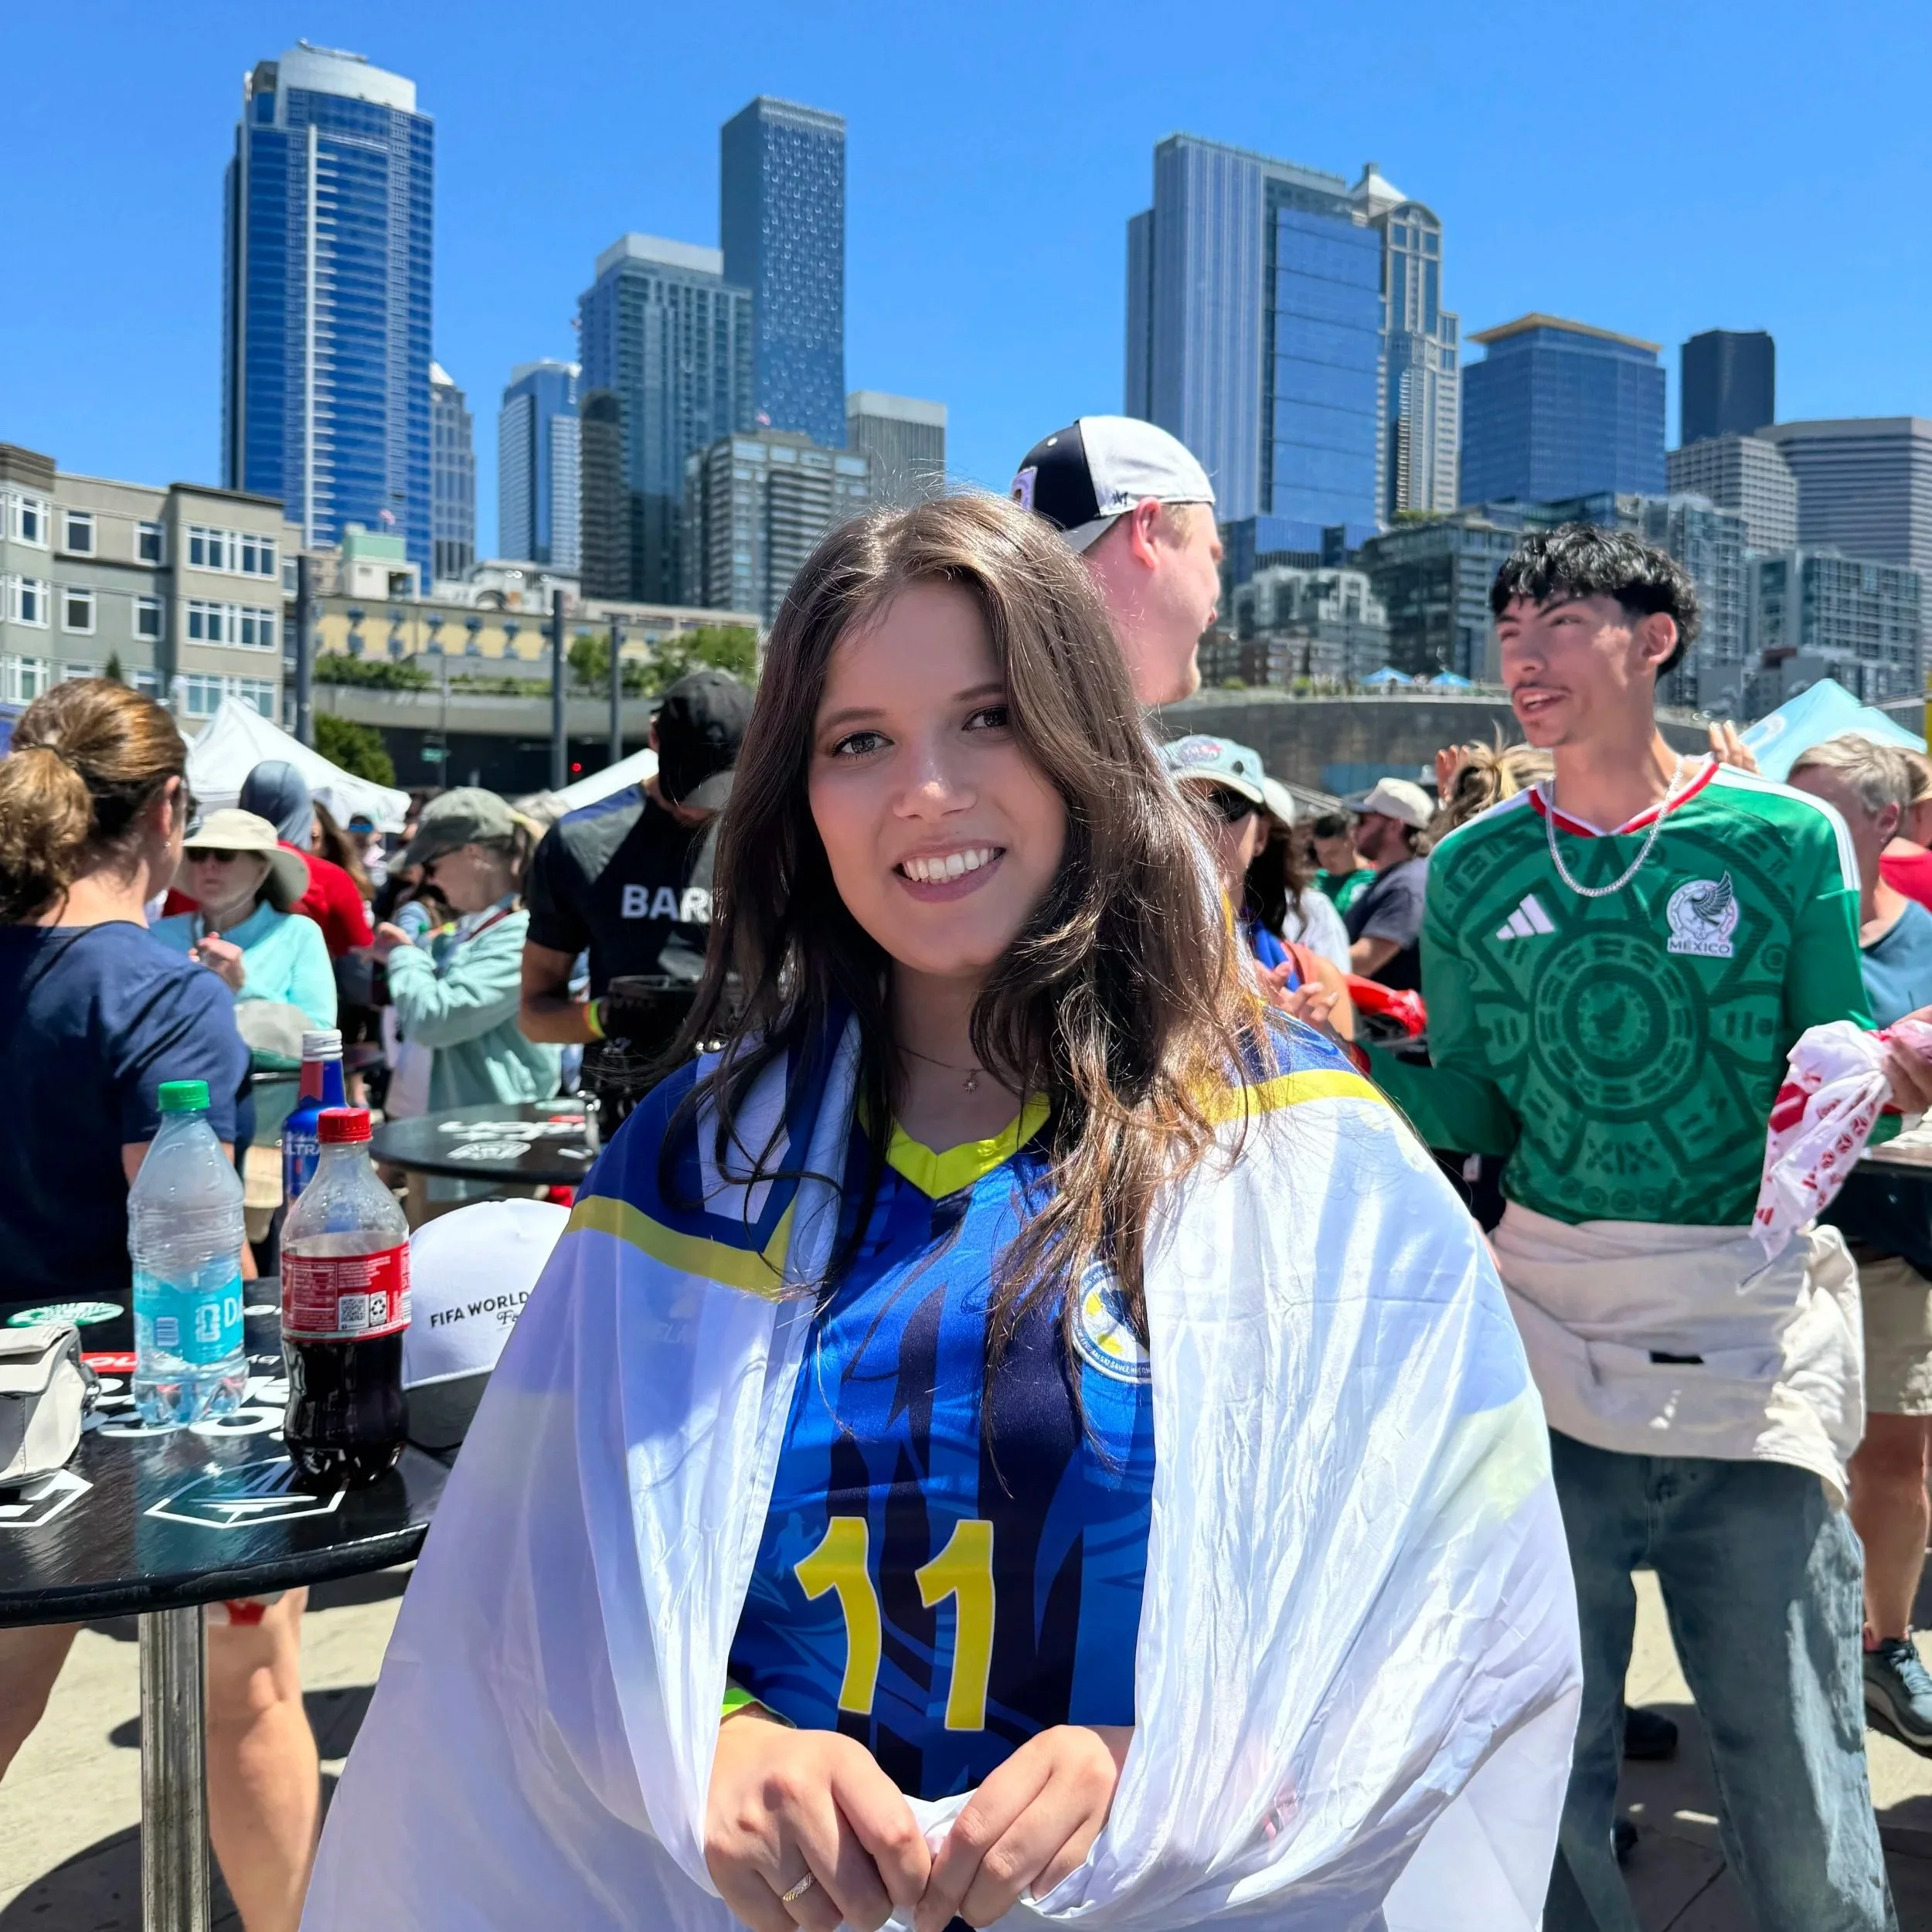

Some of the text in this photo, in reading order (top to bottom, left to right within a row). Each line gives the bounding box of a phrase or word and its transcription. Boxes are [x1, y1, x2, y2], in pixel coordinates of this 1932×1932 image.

[430, 1291, 530, 1328] FIFA WORLD
[794, 1516, 995, 1731] 11
